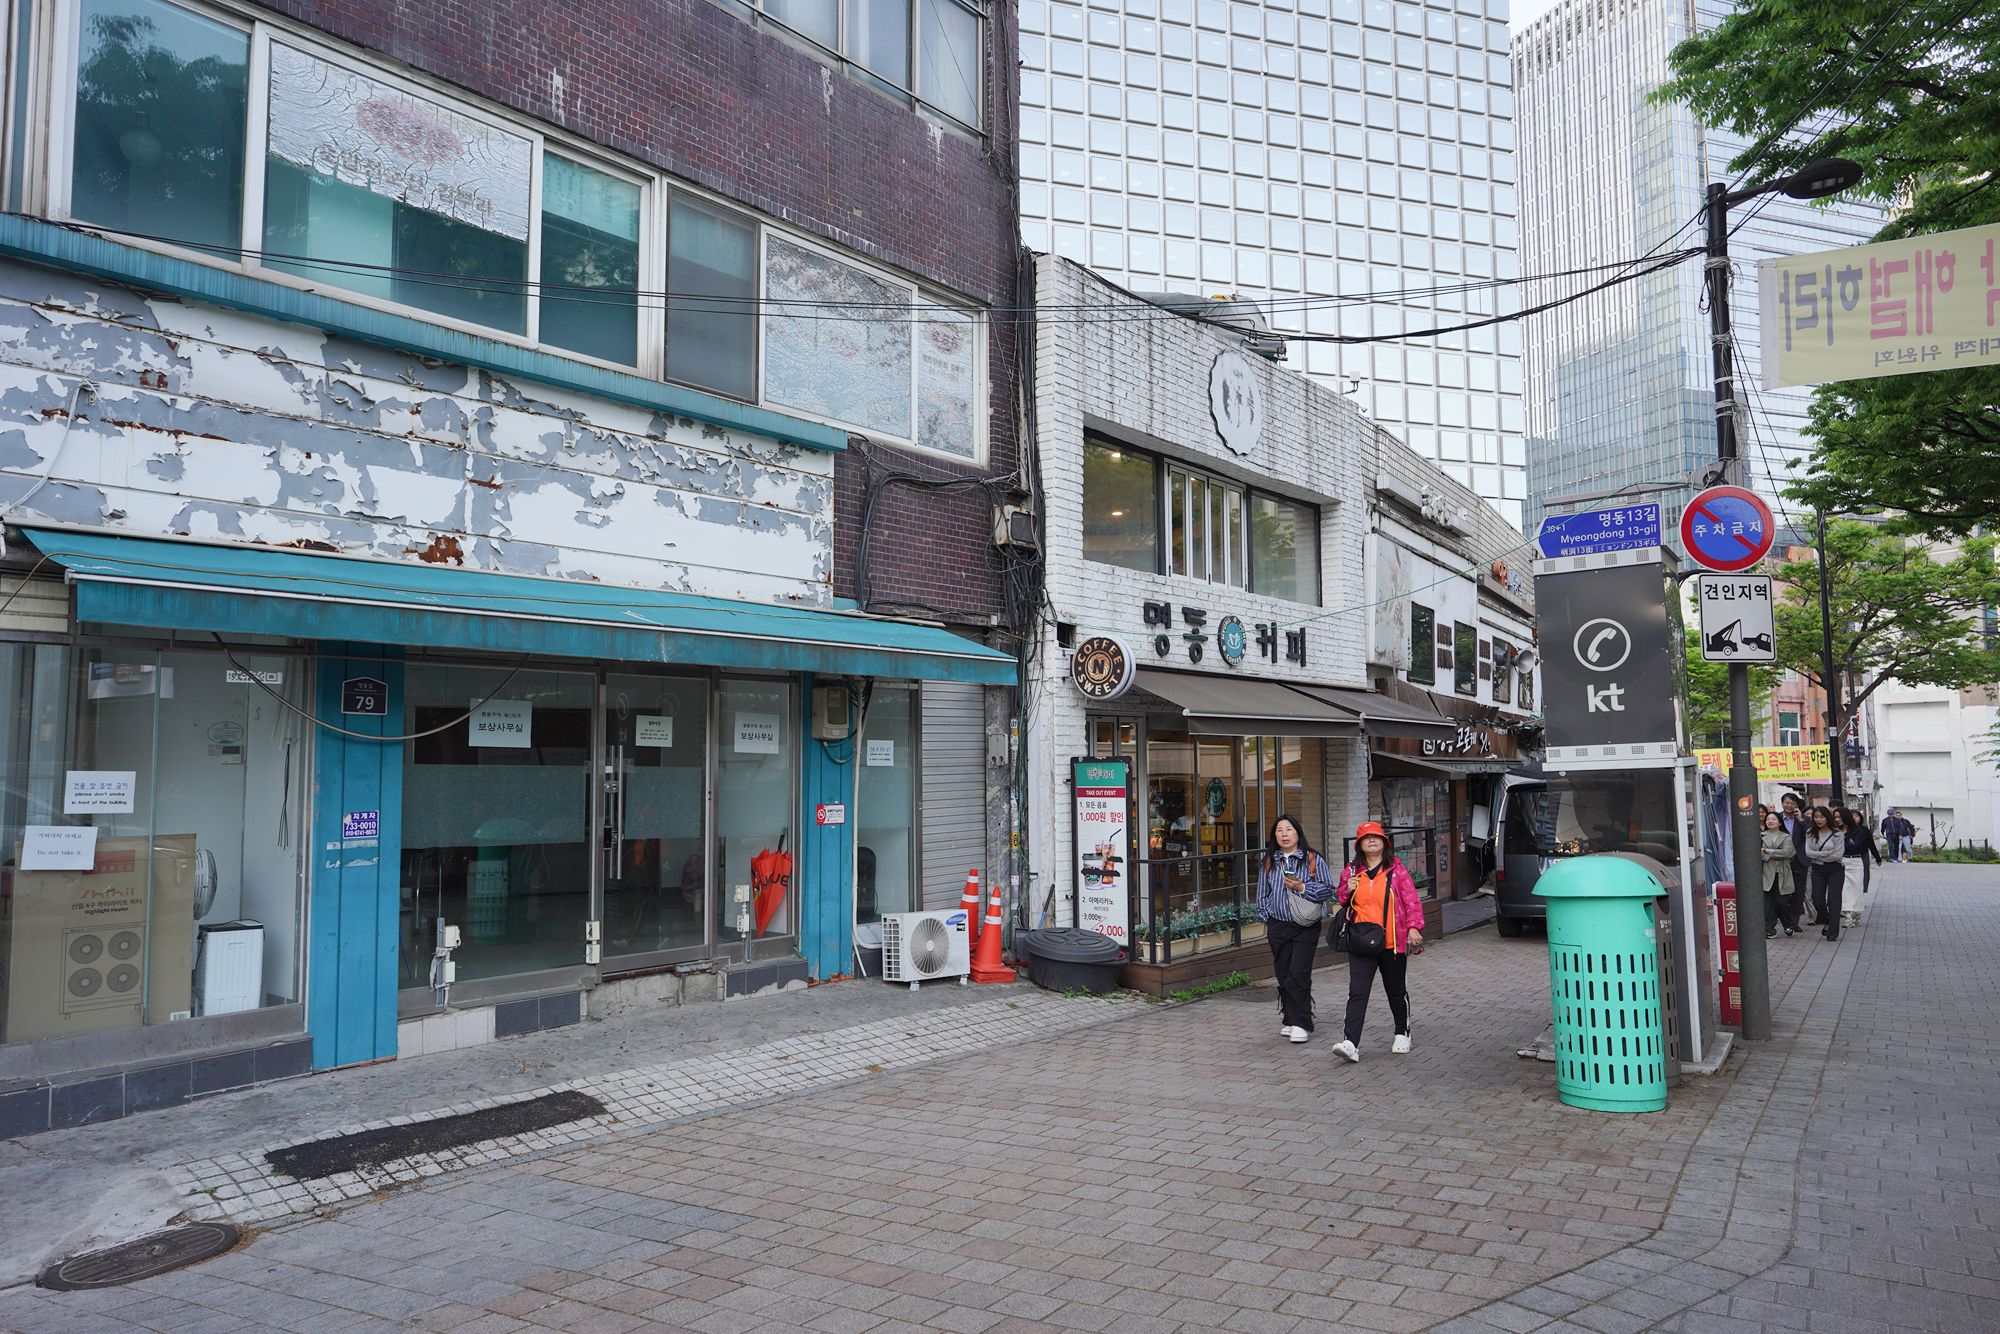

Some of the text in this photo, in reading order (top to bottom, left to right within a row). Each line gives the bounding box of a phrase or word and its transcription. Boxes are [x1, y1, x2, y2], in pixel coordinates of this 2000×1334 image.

[1598, 506, 1656, 528] 명동13길
[1560, 524, 1657, 544] Myeongdong 13-gil
[1694, 520, 1762, 537] 주차금지
[1704, 583, 1768, 601] 견인지역
[1143, 601, 1307, 667] 명동 커피
[1077, 639, 1123, 665] COFFEE
[1093, 659, 1105, 674] N
[1077, 673, 1119, 695] SWEET
[355, 696, 375, 710] 79
[1587, 683, 1625, 713] kt
[478, 722, 523, 733] 보상사무실
[740, 732, 774, 742] 보상사무실
[1768, 750, 1788, 772] 즉각
[1085, 801, 1096, 809] 모든
[1097, 801, 1107, 809] 음료
[1079, 811, 1124, 823] 1,000원 할인
[1089, 896, 1114, 905] 아메리카노
